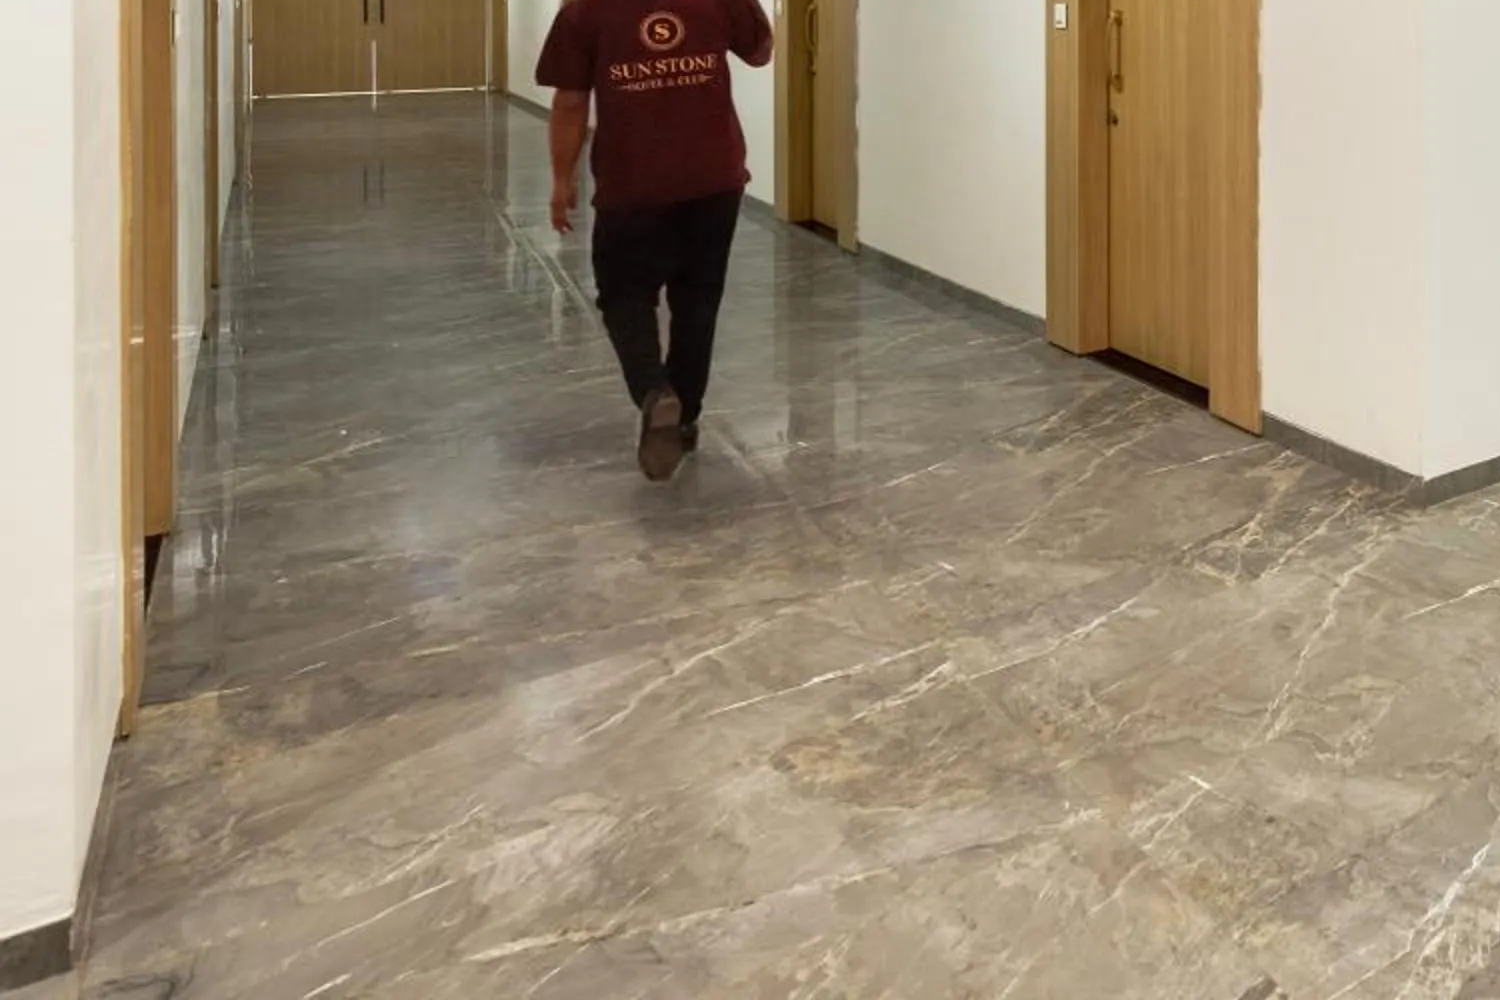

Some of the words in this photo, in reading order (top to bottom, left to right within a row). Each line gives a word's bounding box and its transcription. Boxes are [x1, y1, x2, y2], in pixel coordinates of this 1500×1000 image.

[654, 23, 671, 40] S
[609, 60, 652, 80] SUN
[655, 53, 717, 75] STONE
